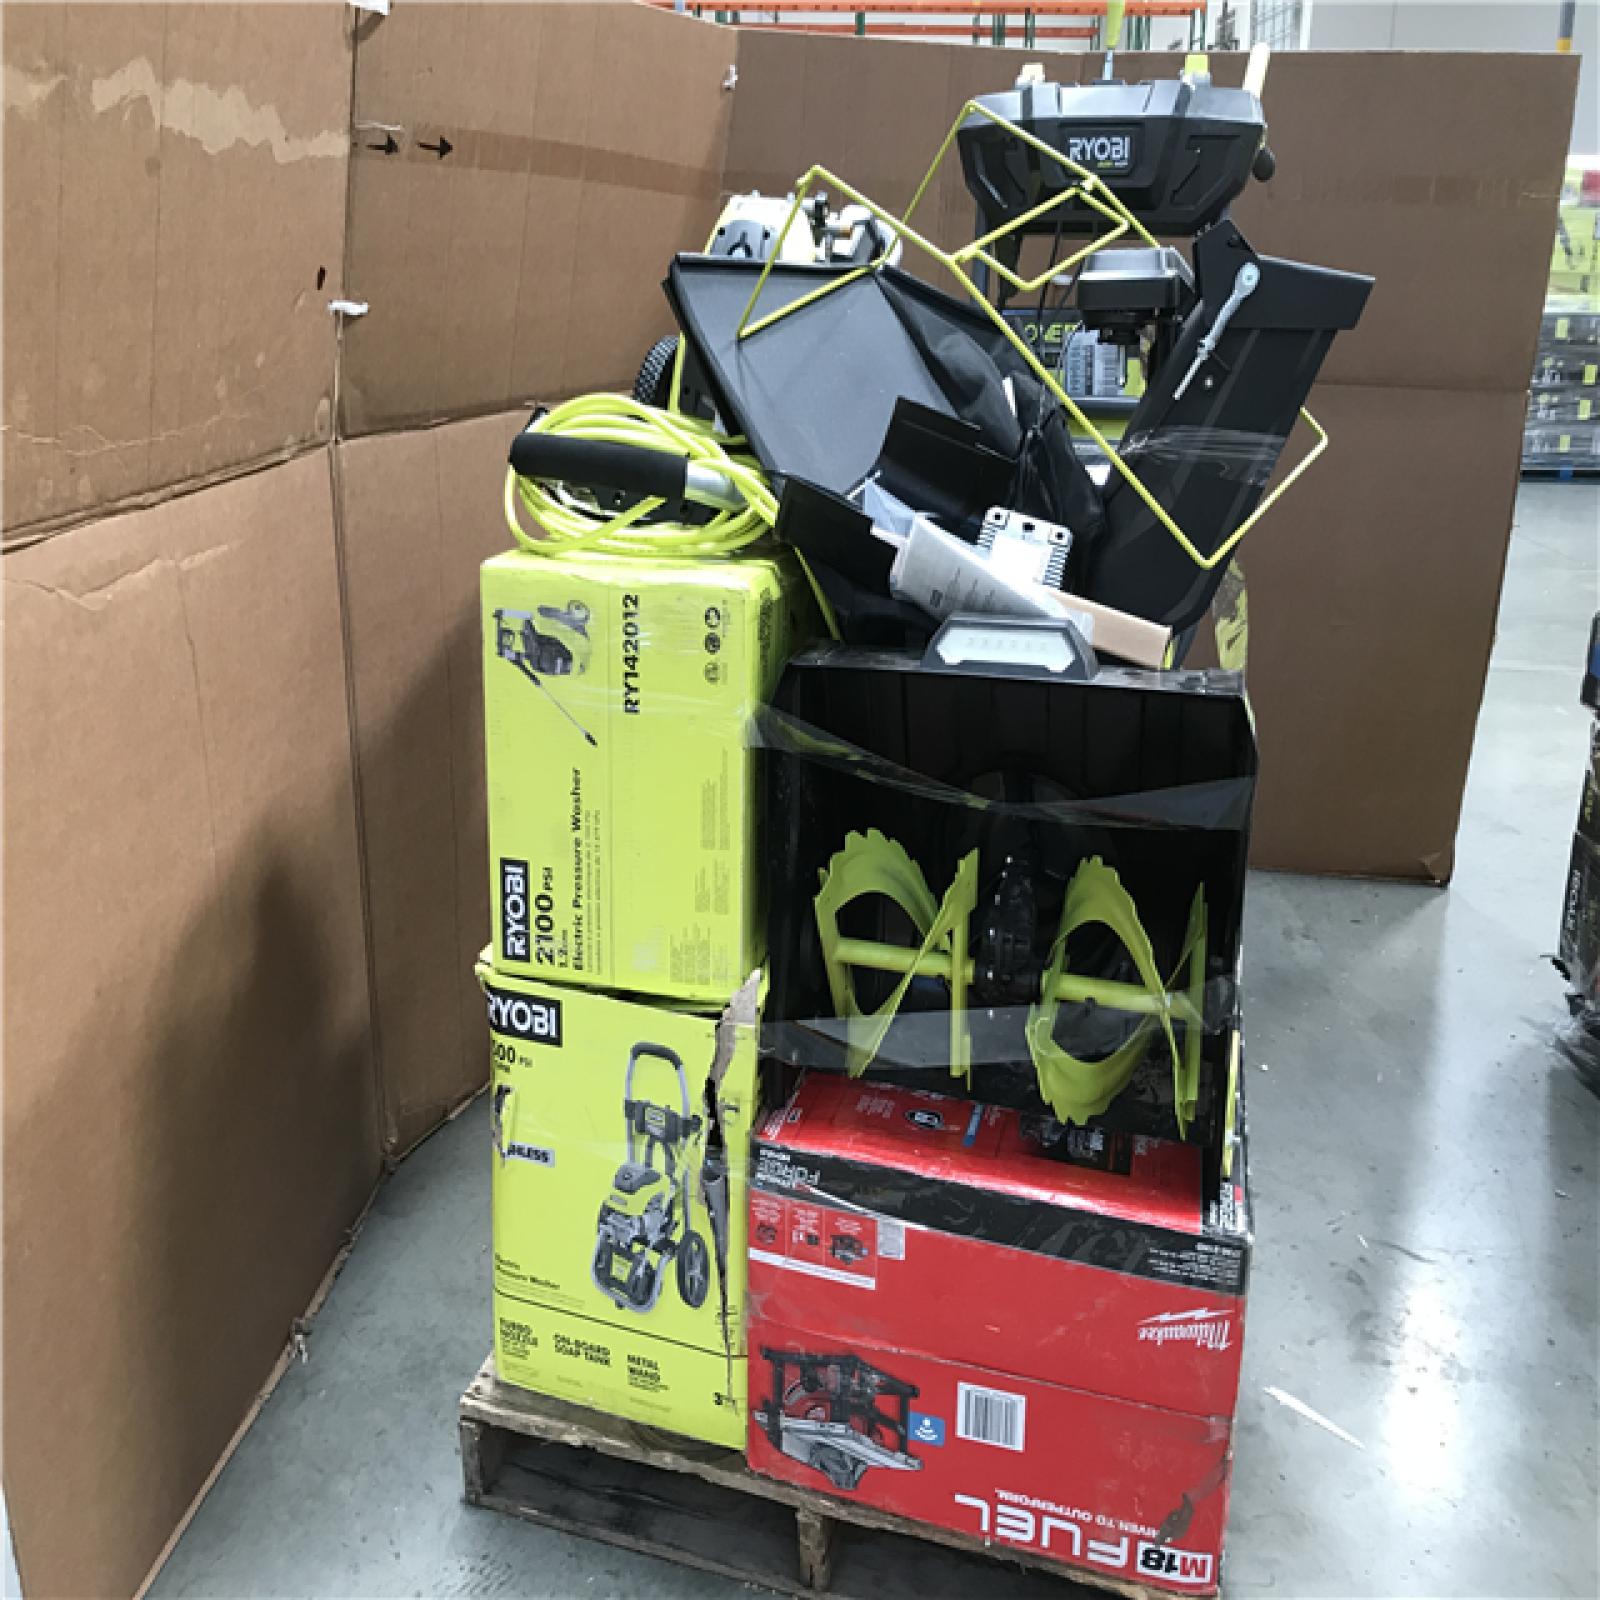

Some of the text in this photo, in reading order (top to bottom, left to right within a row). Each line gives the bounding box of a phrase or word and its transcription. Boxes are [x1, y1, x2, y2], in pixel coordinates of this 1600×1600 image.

[1069, 136, 1130, 161] RYOBI
[622, 593, 639, 714] RY142012
[504, 864, 525, 956] RYOBI
[570, 766, 583, 971] Electric Pressure Washer
[534, 893, 555, 965] 2100
[1138, 1320, 1232, 1351] Milwaukee
[954, 1493, 1208, 1579] M18 FUEL
